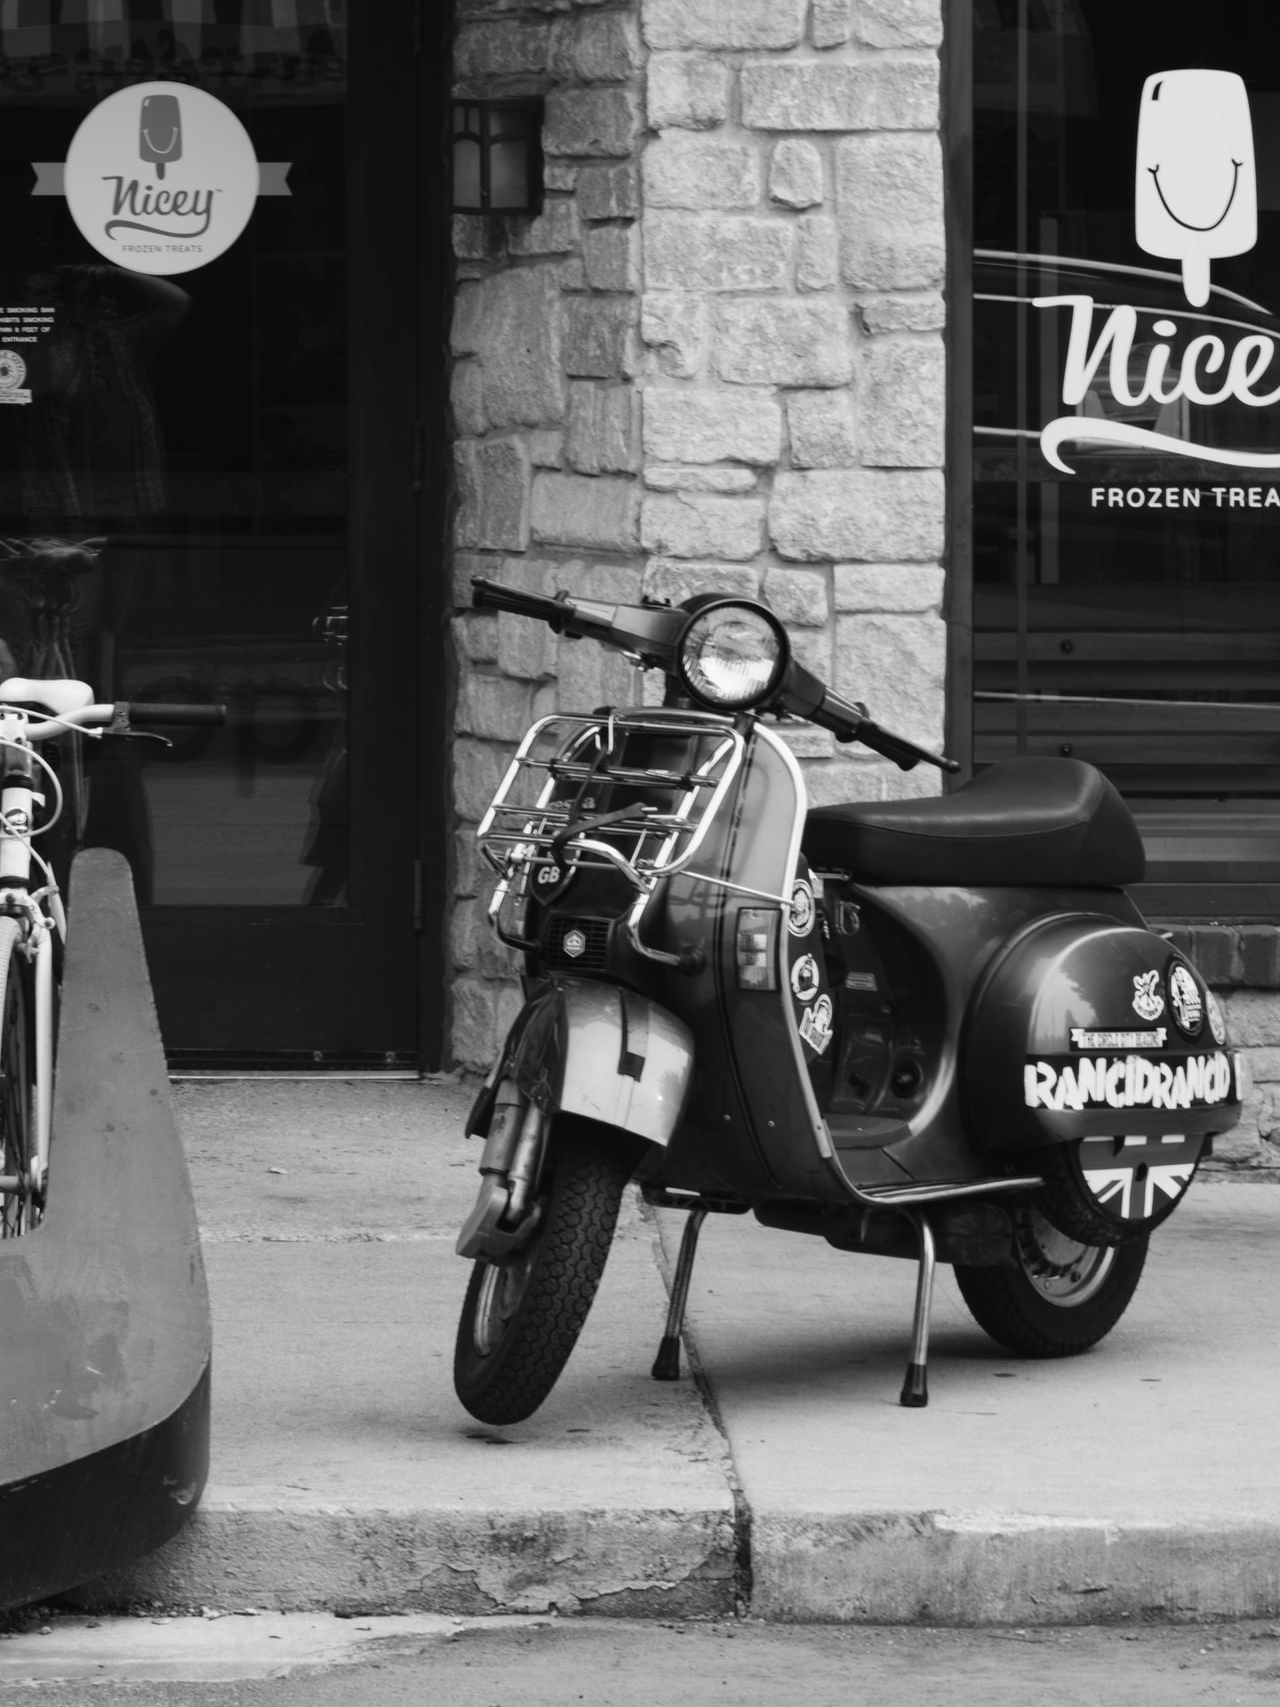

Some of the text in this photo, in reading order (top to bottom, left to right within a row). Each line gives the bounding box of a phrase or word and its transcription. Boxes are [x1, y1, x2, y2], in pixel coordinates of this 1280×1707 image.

[100, 175, 214, 241] Nicey
[121, 244, 203, 253] FROZEN TREATS
[1092, 487, 1201, 508] FROZEN
[537, 866, 561, 885] GB
[1024, 1051, 1231, 1110] RANCID RANCID
